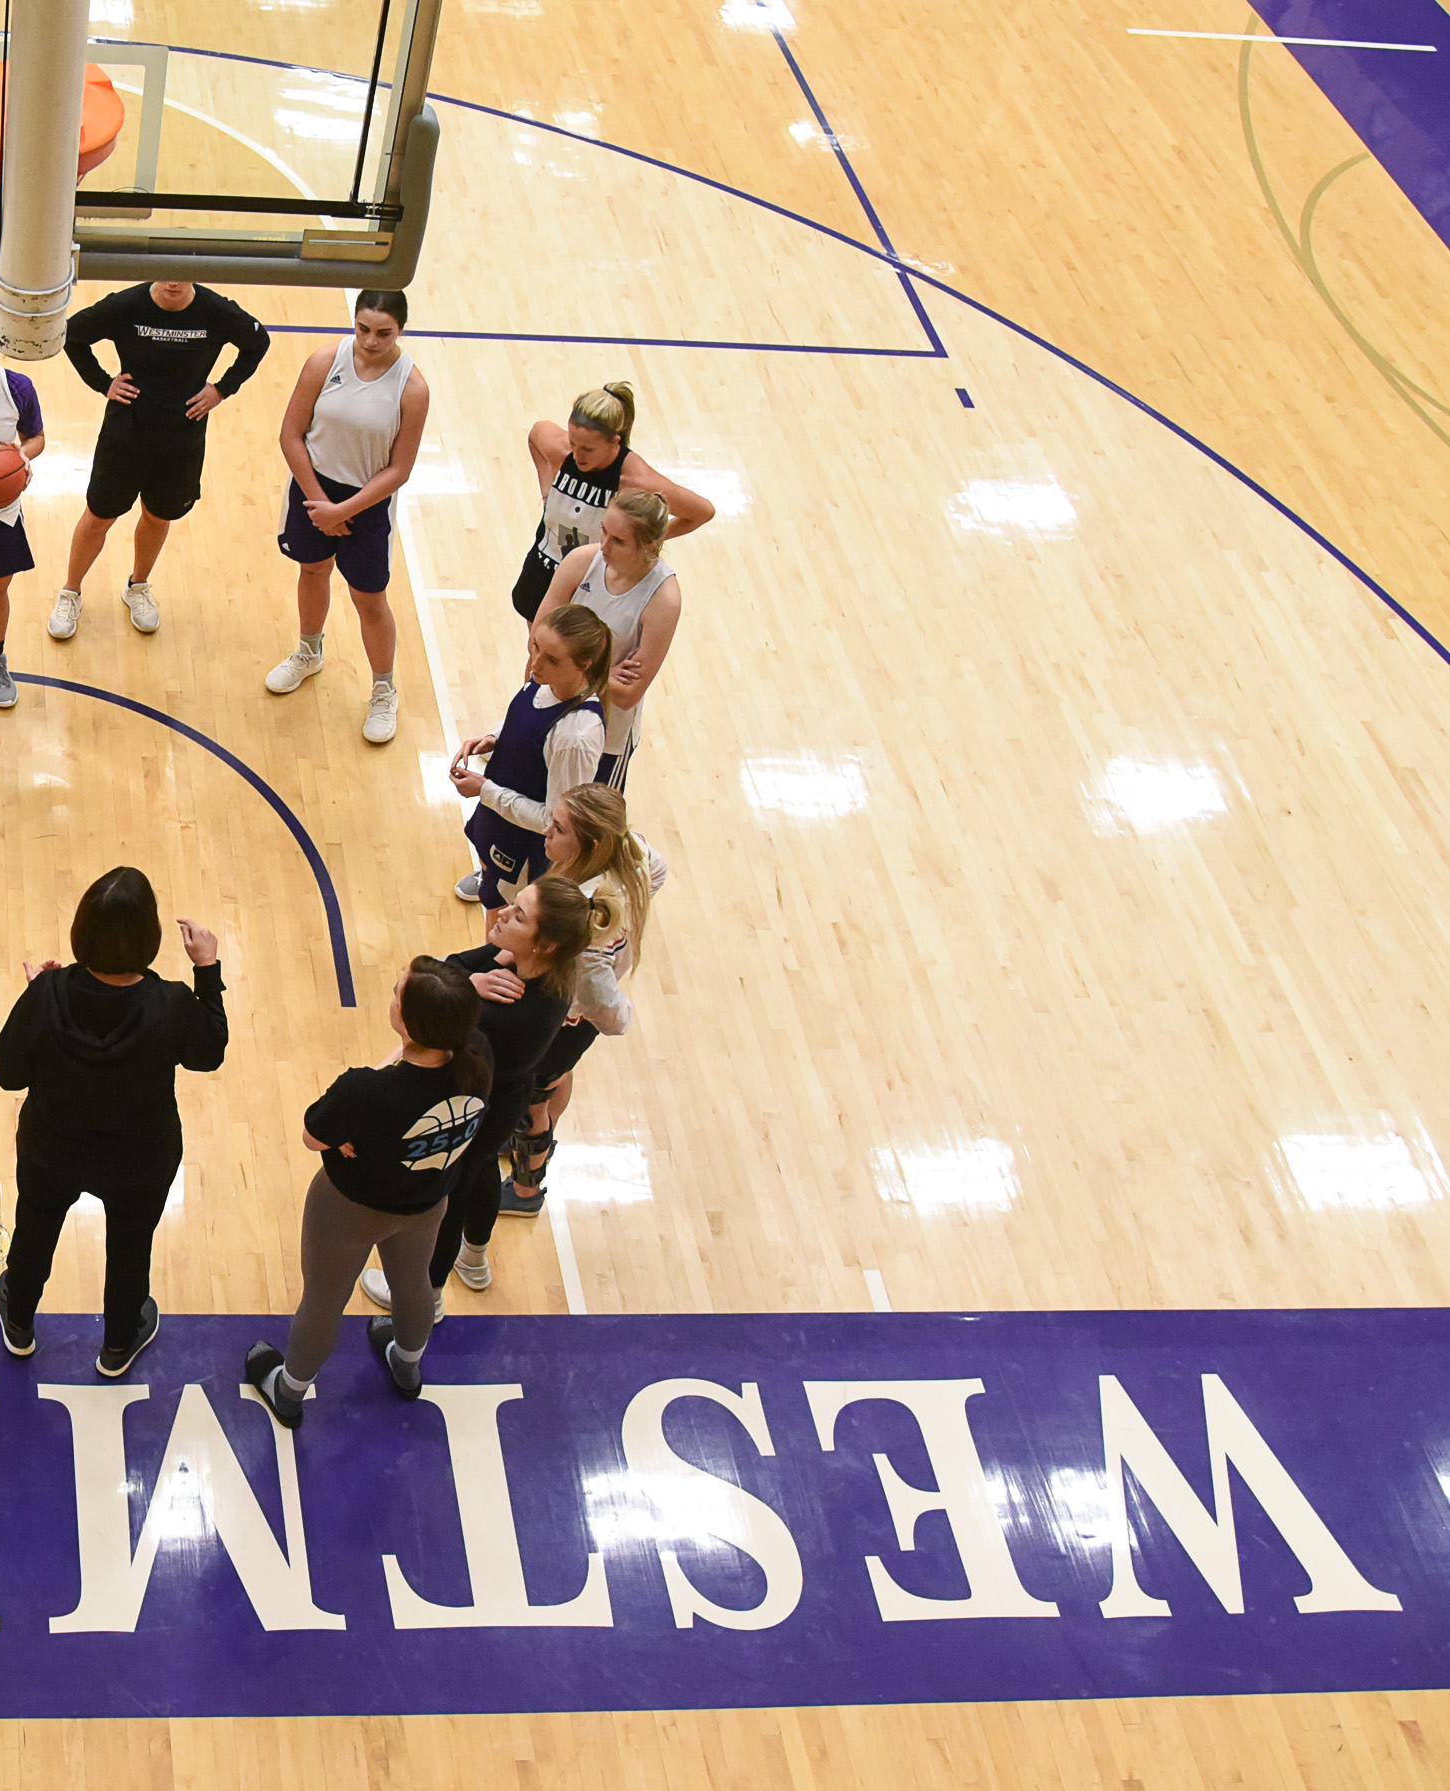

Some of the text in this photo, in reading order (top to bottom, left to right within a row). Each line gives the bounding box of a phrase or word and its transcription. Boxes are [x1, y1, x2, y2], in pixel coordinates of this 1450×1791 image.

[134, 325, 207, 338] WESTMINSTER
[552, 470, 618, 507] BROOKLY
[406, 1117, 479, 1157] 25-0
